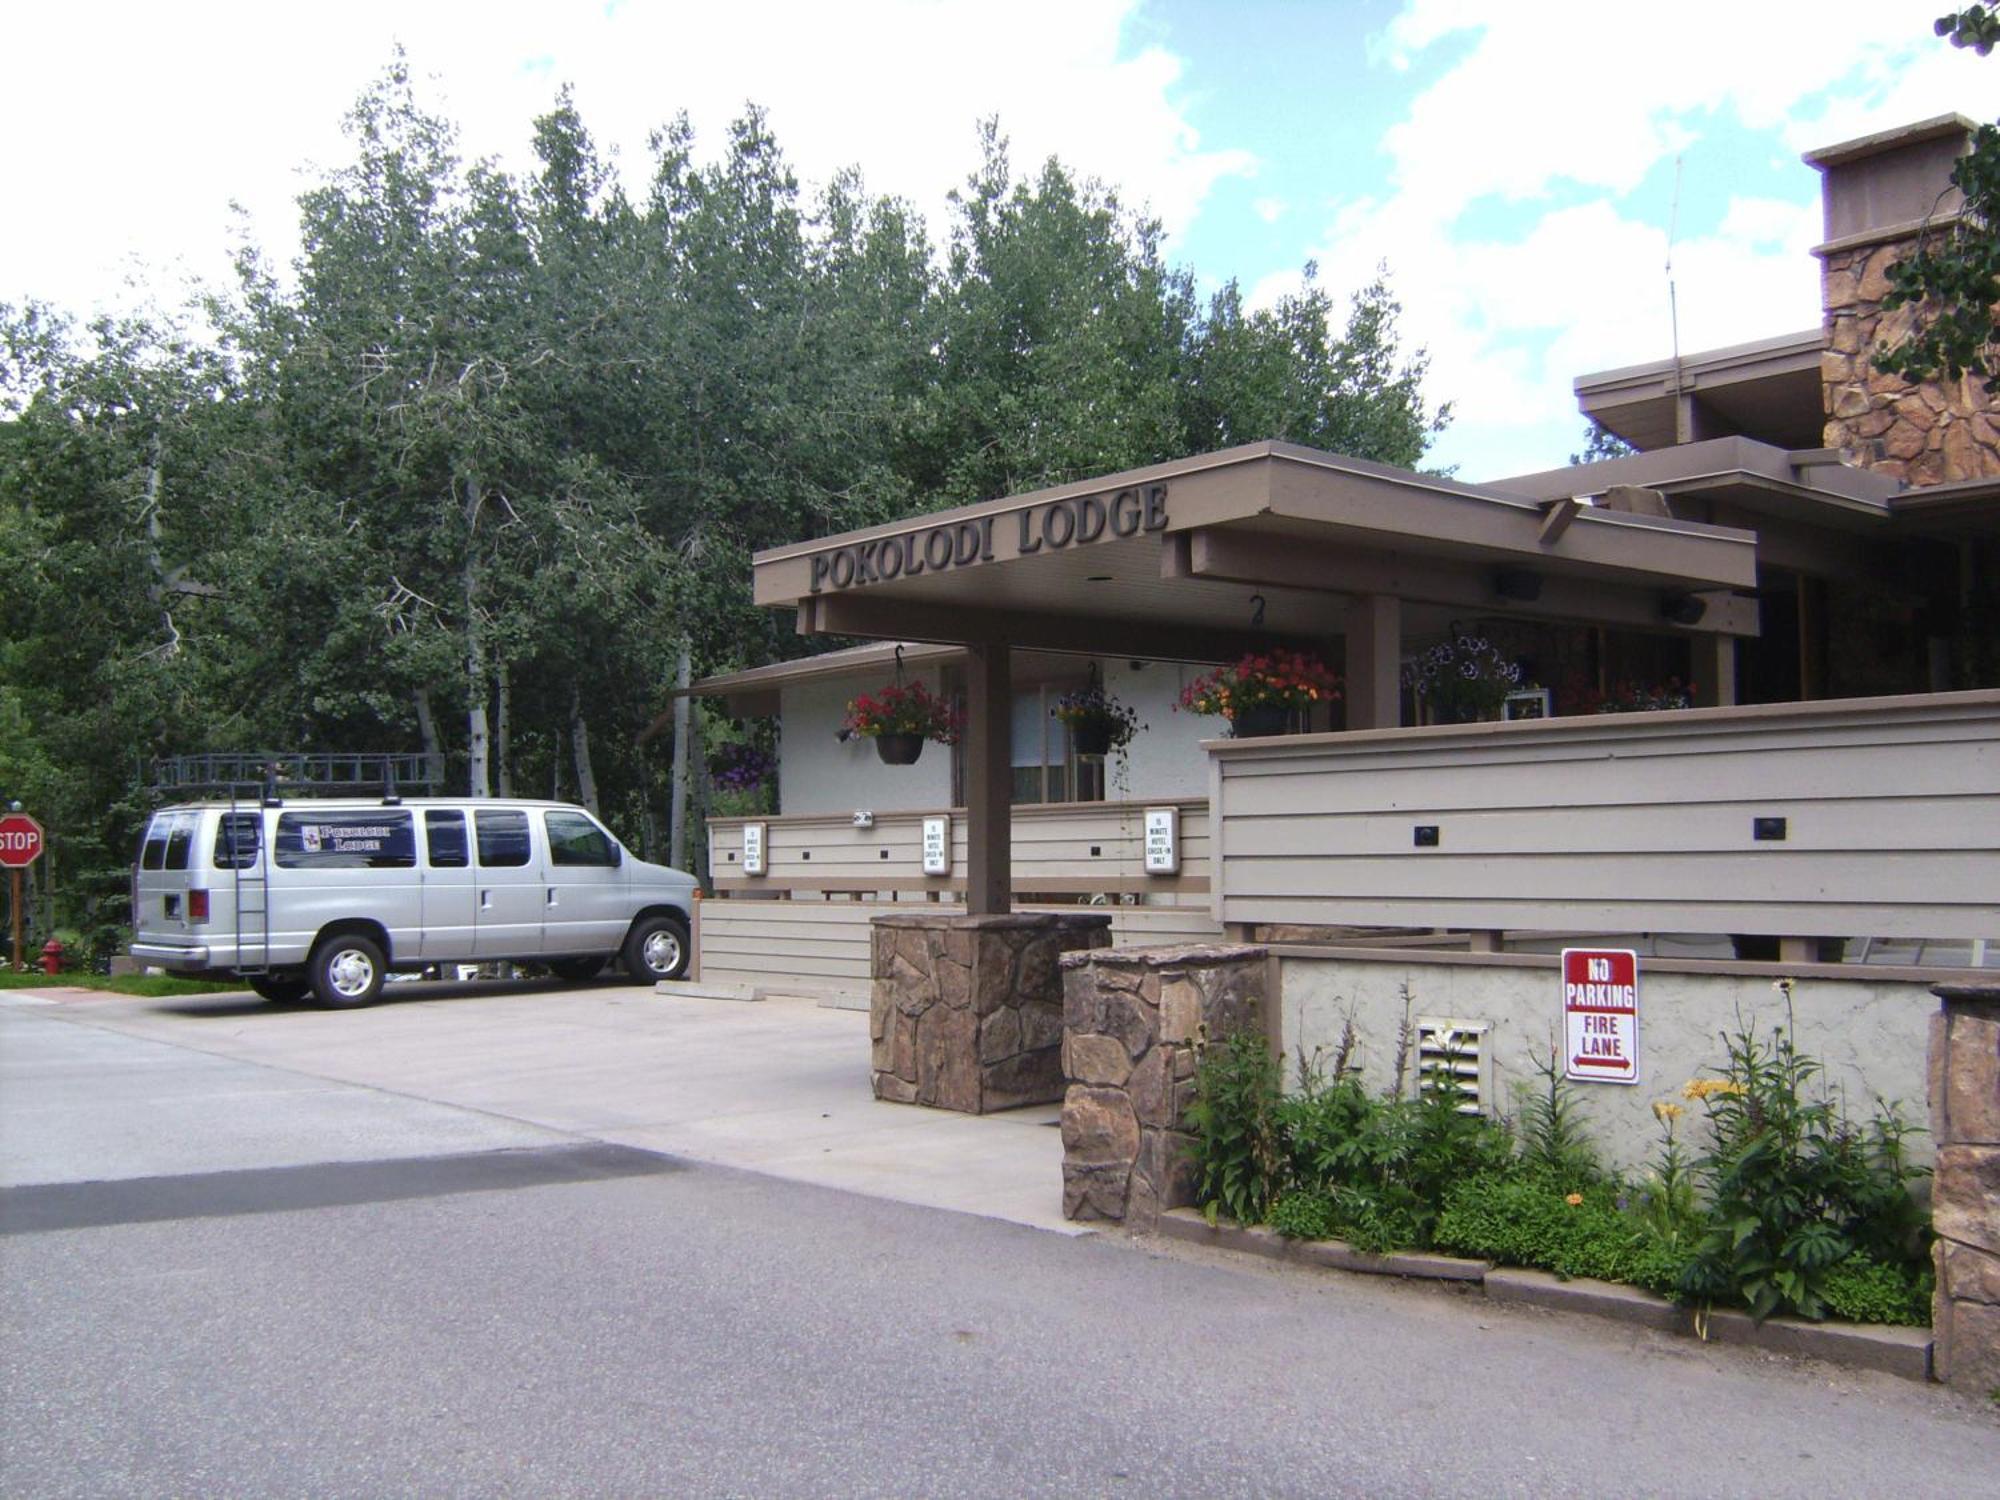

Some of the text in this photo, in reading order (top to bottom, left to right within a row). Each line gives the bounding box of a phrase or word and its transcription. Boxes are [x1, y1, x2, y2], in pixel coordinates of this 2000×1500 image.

[810, 482, 1170, 594] POKOLODI LODGE
[1588, 958, 1611, 982] NO
[1567, 983, 1633, 1008] PARKING
[1584, 1015, 1618, 1035] FIRE
[1582, 1037, 1621, 1056] LANE
